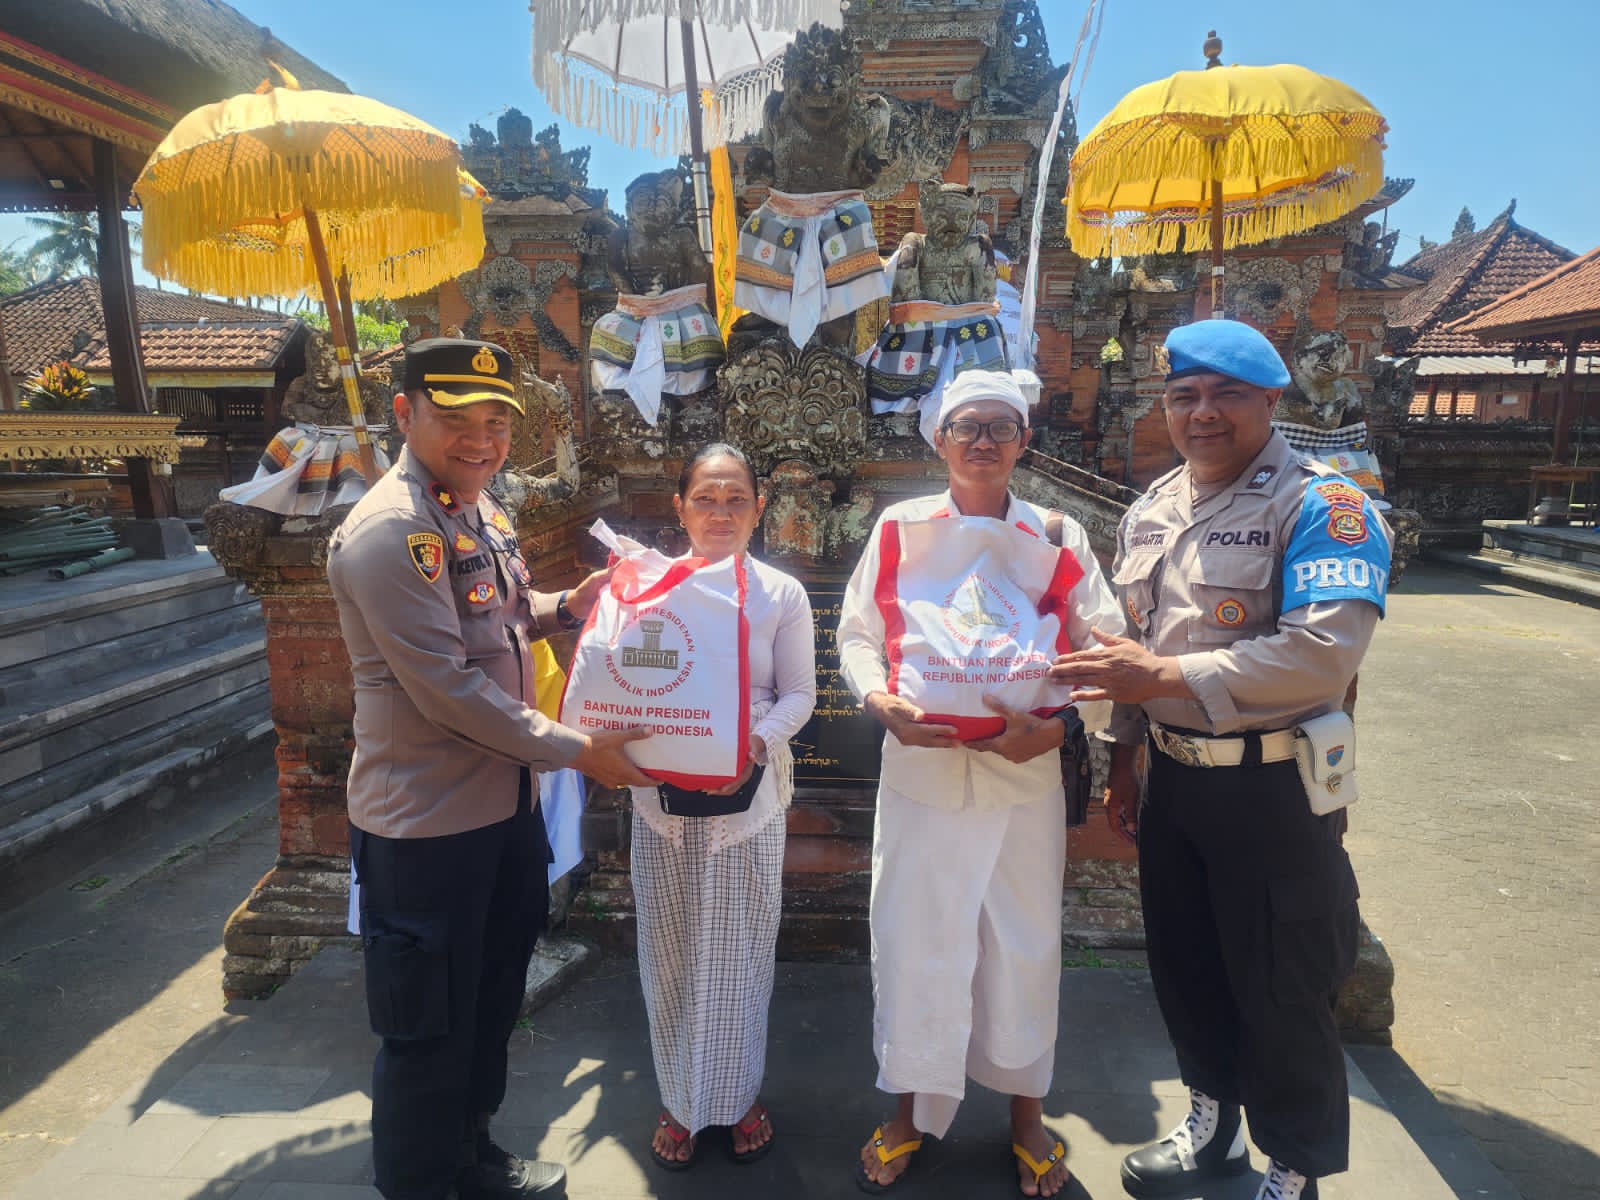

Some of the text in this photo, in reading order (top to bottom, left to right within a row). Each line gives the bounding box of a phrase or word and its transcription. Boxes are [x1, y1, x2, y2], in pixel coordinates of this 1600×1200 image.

[1206, 531, 1271, 547] POLRI
[1293, 557, 1387, 596] PROV
[605, 654, 695, 696] REPUBLIK INDONESIA
[922, 671, 984, 684] REPUBLIK
[584, 700, 710, 720] BANTUAN PRESIDEN
